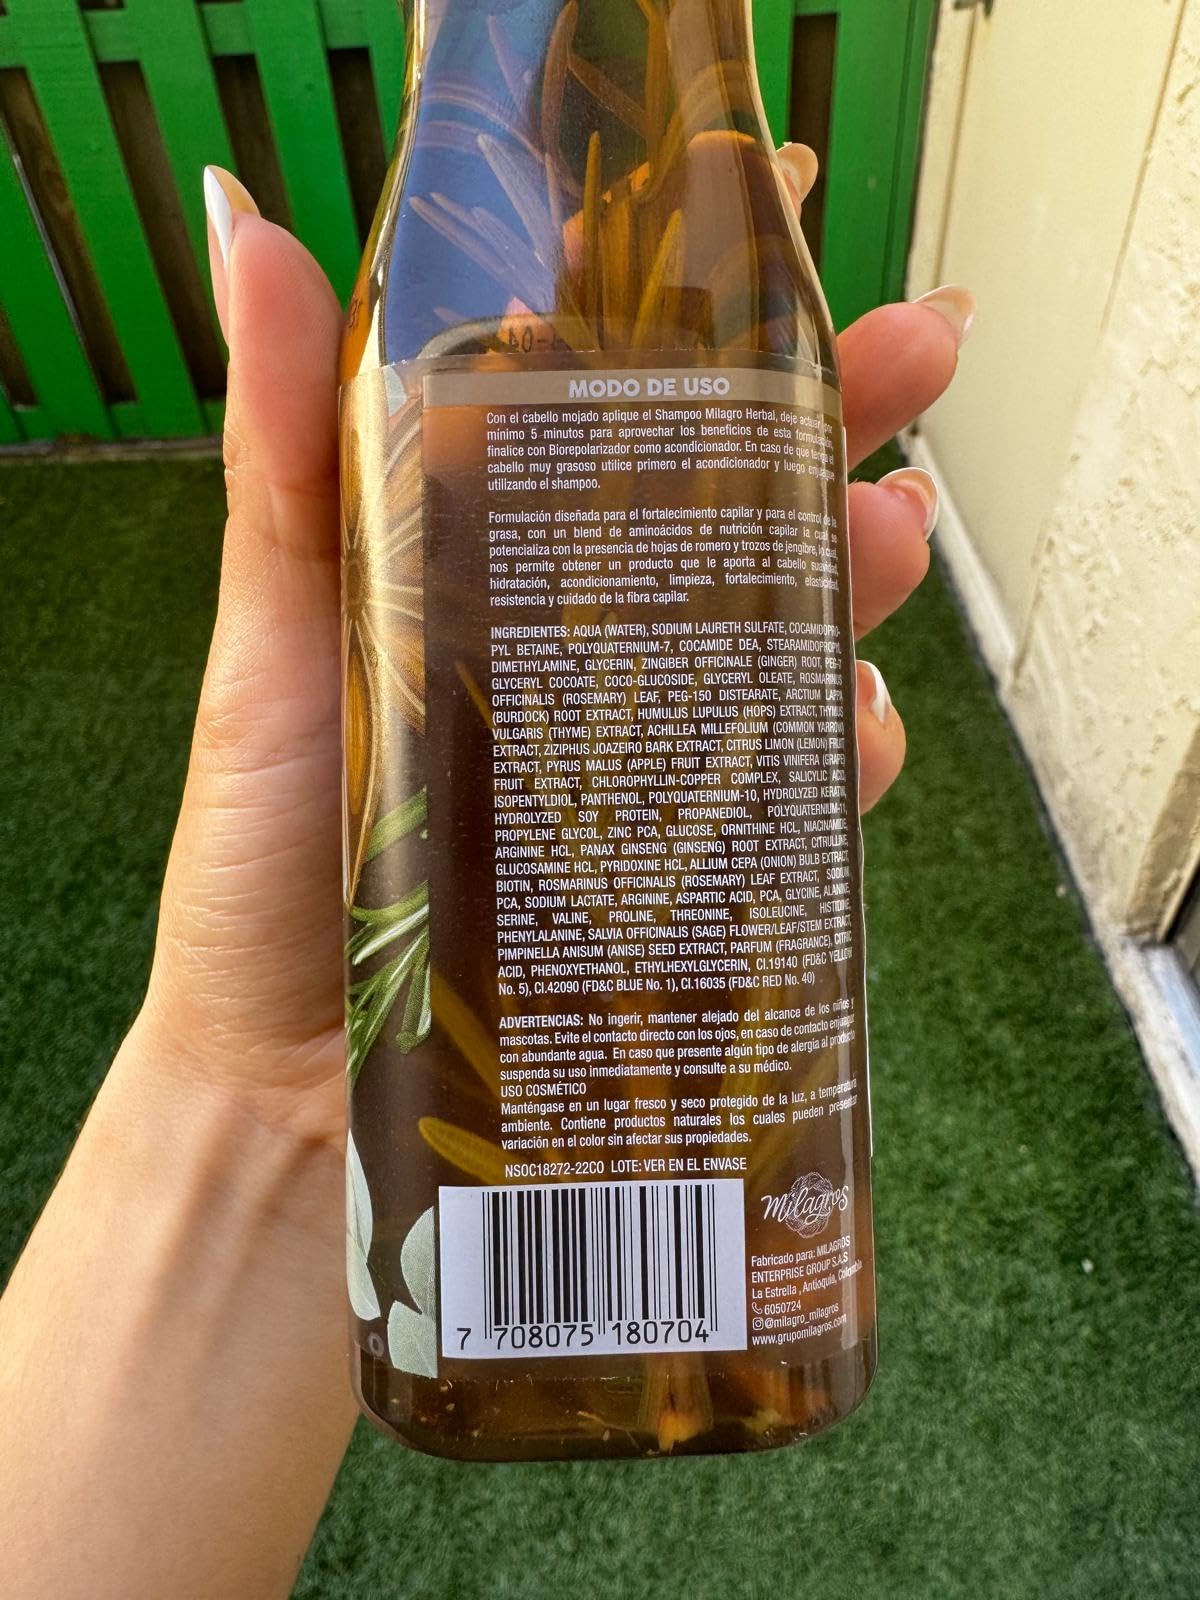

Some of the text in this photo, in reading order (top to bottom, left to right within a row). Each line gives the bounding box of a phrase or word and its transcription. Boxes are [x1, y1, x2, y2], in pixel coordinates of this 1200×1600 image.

[569, 377, 729, 397] MODO DE USO
[602, 408, 742, 423] aplique Shampoo Milagro
[543, 424, 751, 439] minutos aprovechar beneficios
[486, 441, 742, 456] finalice Biorepolarizador acondicionador.
[556, 458, 768, 474] grasoso primero acondicionador
[487, 478, 600, 491] utilizando shampoo.
[488, 507, 717, 522] Formulación diseñada fortalecimiento
[489, 523, 762, 542] grasa, aminoácidos nutrición
[489, 542, 730, 558] potencializa presencia romero
[515, 558, 673, 574] permite obtener producto
[490, 574, 714, 590] hidratación, acondicionamiento, limpieza,
[490, 590, 689, 605] resistencia cuidado capilar.
[490, 622, 741, 638] INGREDIENTES: (WATER), LAURETH
[516, 639, 732, 657] BETAINE, POLYQUATERNIUM-7, COCAMIDE
[491, 656, 752, 674] DIMETHYLAMINE, GLYCERIN, ZINGIBER OFFICINALE
[491, 672, 753, 689] GLYCERYL COCOATE, COCO-GLUCOSIDE, GLYCERYL
[492, 688, 781, 706] OFFICINALIS (ROSEMARY) DISTEARATE,
[492, 706, 738, 724] (BURDOCK) EXTRACT, HUMULUS LUPULUS
[492, 722, 768, 739] VULGARIS EXTRACT, ACHILLEA MILLEFOLIUM
[493, 740, 723, 757] EXTRACT, ZIZIPHUS JOAZEIRO EXTRACT,
[493, 756, 752, 774] EXTRACT, (APPLE) EXTRACT,
[534, 772, 781, 790] EXTRACT, CHLOROPHYLLIN-COPPER COMPLEX,
[494, 789, 759, 808] ISOPENTYLDIOL, PANTHENOL, POLYQUATERNIUM-10,
[494, 807, 752, 824] HYDROLYZED PROTEIN, PROPANEDIOL,
[494, 822, 775, 841] PROPYLENE GLUCOSE, ORNITHINE
[494, 841, 725, 858] ARGININE GINSENG (GINSENG)
[495, 857, 727, 875] GLUCOSAMINE PYRIDOXINE ALLIUM
[538, 874, 745, 890] ROSMARINUS OFFICINALIS (ROSEMARY)
[570, 891, 725, 908] LACTATE, ARGININE, ASPARTIC
[496, 908, 732, 927] SERINE, PROLINE, THREONINE,
[497, 926, 688, 944] PHENYLALANINE, SALVIA OFFICINALIS
[497, 941, 772, 960] PIMPINELLA EXTRACT, PARFUM
[497, 959, 750, 979] ACID, PHENOXYETHANOL, ETHYLHEXYLGLYCERIN,
[582, 976, 760, 994] (FD&C BLUE (FD&C
[499, 1010, 739, 1028] ADVERTENCIAS: mantener alejado
[499, 1029, 674, 1046] mascotas. contacto directo
[521, 1046, 722, 1062] abundante agua. presente
[500, 1062, 726, 1081] suspenda inmediatamente consulte
[500, 1082, 586, 1097] USO COSMÉTICO
[501, 1095, 758, 1116] Manténgase fresco protegido
[501, 1114, 721, 1132] ambiente. Contiene productos naturales
[501, 1131, 751, 1149] variación afectar propiedades.
[611, 1159, 642, 1172] LOTE:
[643, 1159, 665, 1171] VER
[668, 1158, 683, 1171] EN
[687, 1158, 700, 1170] EL
[703, 1157, 747, 1170] ENVASE
[761, 1185, 849, 1225] Milagros
[751, 1254, 794, 1267] Fabricado
[751, 1266, 804, 1283] ENTERPRISE
[806, 1260, 831, 1276] GROUP
[752, 1285, 797, 1299] La Estrella
[764, 1301, 801, 1315] 6050724
[764, 1303, 839, 1329] @milagro_milagros
[457, 1320, 709, 1350] 7 708075 180704
[752, 1314, 847, 1345] www.grupomilagros.com
